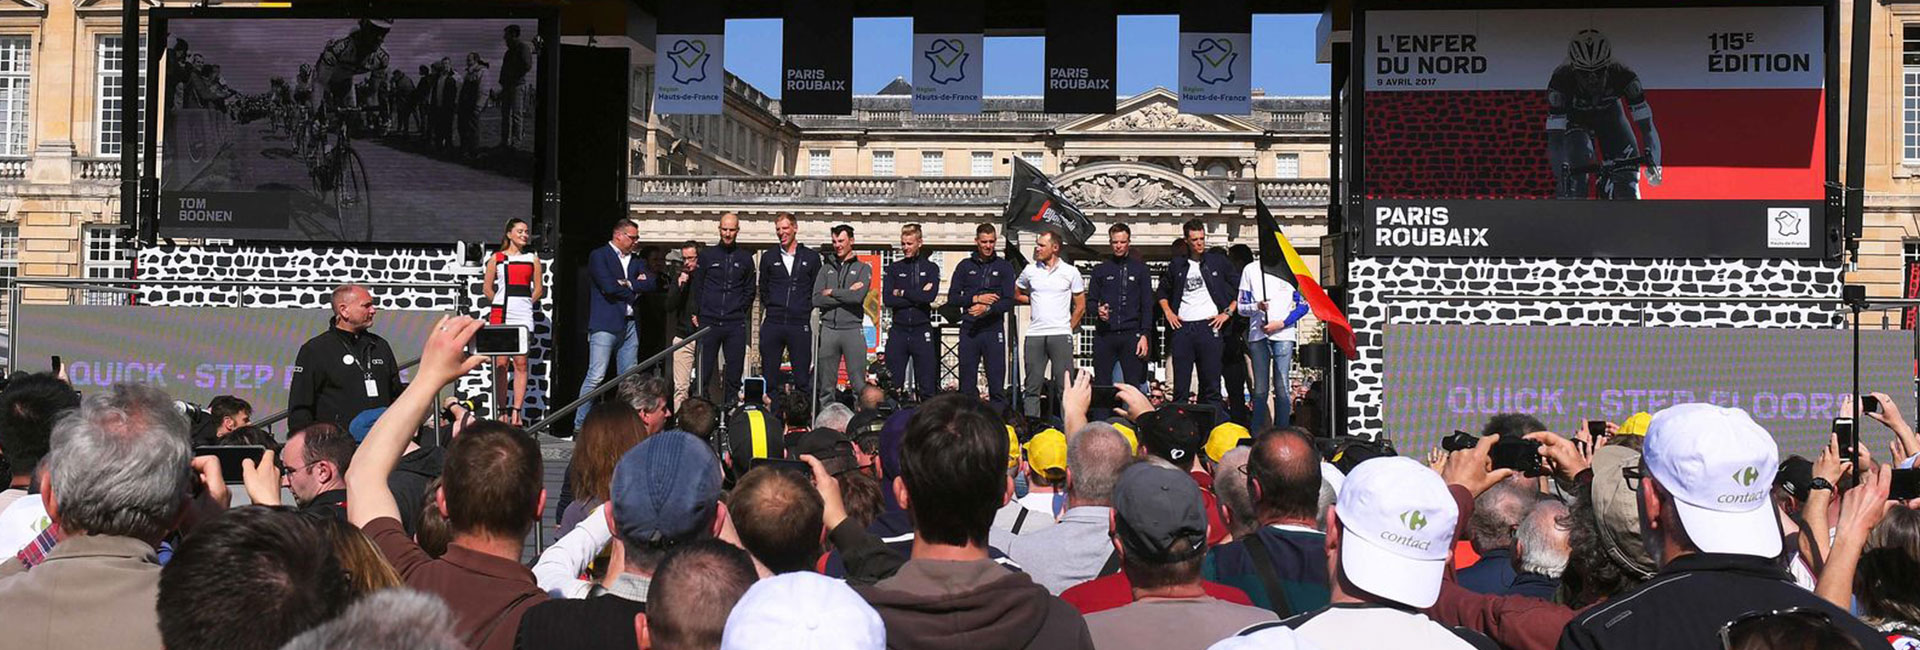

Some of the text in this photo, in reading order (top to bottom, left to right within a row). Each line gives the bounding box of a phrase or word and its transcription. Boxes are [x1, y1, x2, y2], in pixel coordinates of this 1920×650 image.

[1377, 35, 1477, 53] L'ENFER
[1377, 56, 1488, 74] DU NORD
[1708, 50, 1810, 72] ÉDITION
[787, 69, 825, 80] PARIS
[1050, 68, 1089, 78] PARIS
[787, 80, 845, 91] ROUBAIX
[1050, 79, 1109, 90] ROUBAIX
[658, 93, 719, 101] Hauts-de-France
[915, 93, 978, 101] Hauts-de-France
[1182, 93, 1247, 102] Hauts-de-France
[179, 198, 206, 209] TOM
[179, 210, 232, 221] BOONEN
[1376, 207, 1449, 226] PARIS
[1376, 228, 1489, 247] ROUBAIX
[69, 361, 168, 386] QUICK
[195, 364, 274, 389] STEP
[1448, 387, 1565, 414] QUICK
[1717, 490, 1764, 504] contact
[1380, 531, 1432, 551] contact
